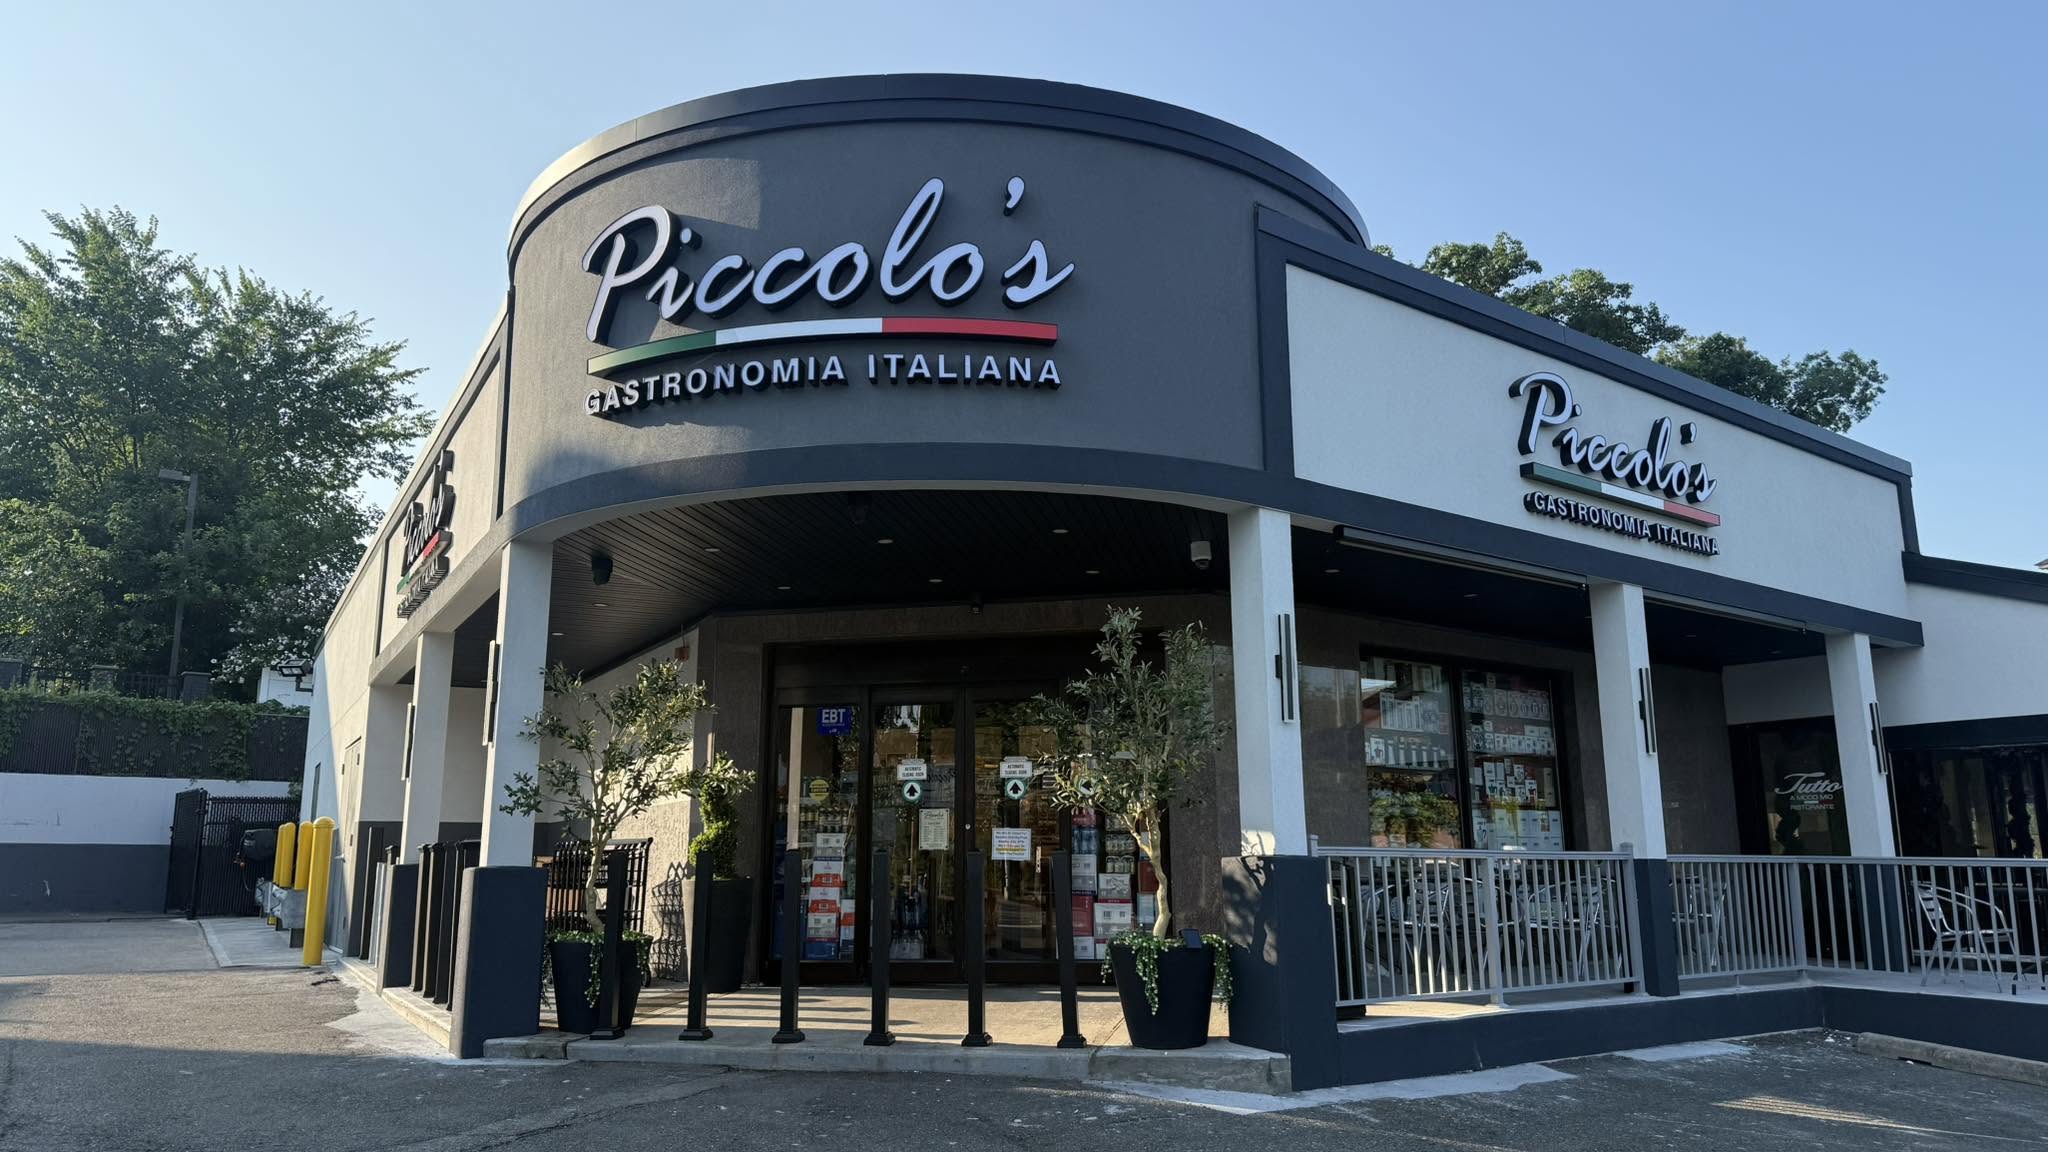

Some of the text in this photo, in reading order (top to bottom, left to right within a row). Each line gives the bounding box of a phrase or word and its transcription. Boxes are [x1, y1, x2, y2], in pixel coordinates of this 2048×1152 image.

[581, 176, 1076, 344] Piccolo's
[584, 353, 1062, 416] GASTRONOMIA ITALIANA
[1509, 371, 1717, 504] Piccolo's
[1525, 491, 1720, 556] GASTRONOMIA ITALIANA
[822, 708, 846, 723] EBT
[1774, 772, 1843, 795] Tutto
